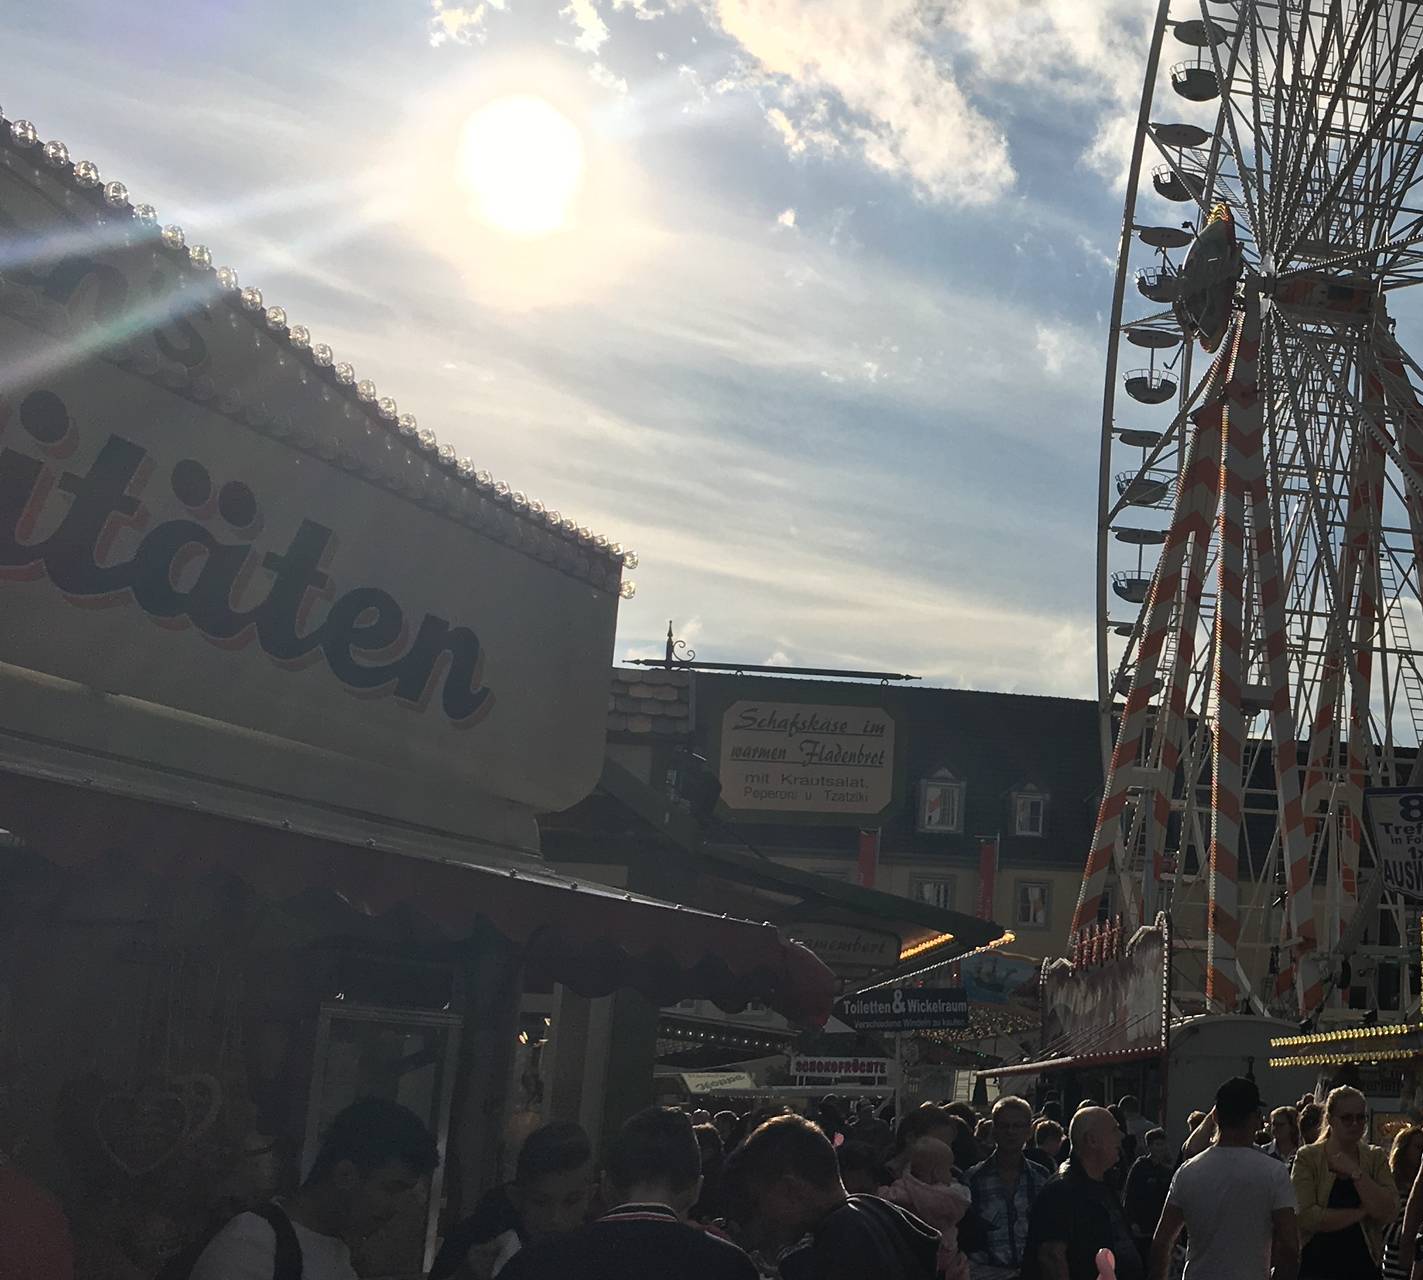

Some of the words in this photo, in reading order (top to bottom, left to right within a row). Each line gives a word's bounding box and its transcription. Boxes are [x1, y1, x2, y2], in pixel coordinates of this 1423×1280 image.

[732, 708, 848, 737] Schafskäse
[862, 720, 885, 735] im
[730, 744, 787, 761] warmen
[800, 739, 885, 767] Fladenbrot
[745, 773, 769, 785] mit
[744, 786, 797, 801] Peperoni
[823, 790, 868, 803] Tzatziki
[1390, 835, 1402, 845] in
[843, 1000, 892, 1015] Toiletten
[892, 989, 906, 1014] &
[907, 999, 968, 1014] Wickelraum
[795, 1058, 887, 1075] SCHOKOFRÜCHTE
